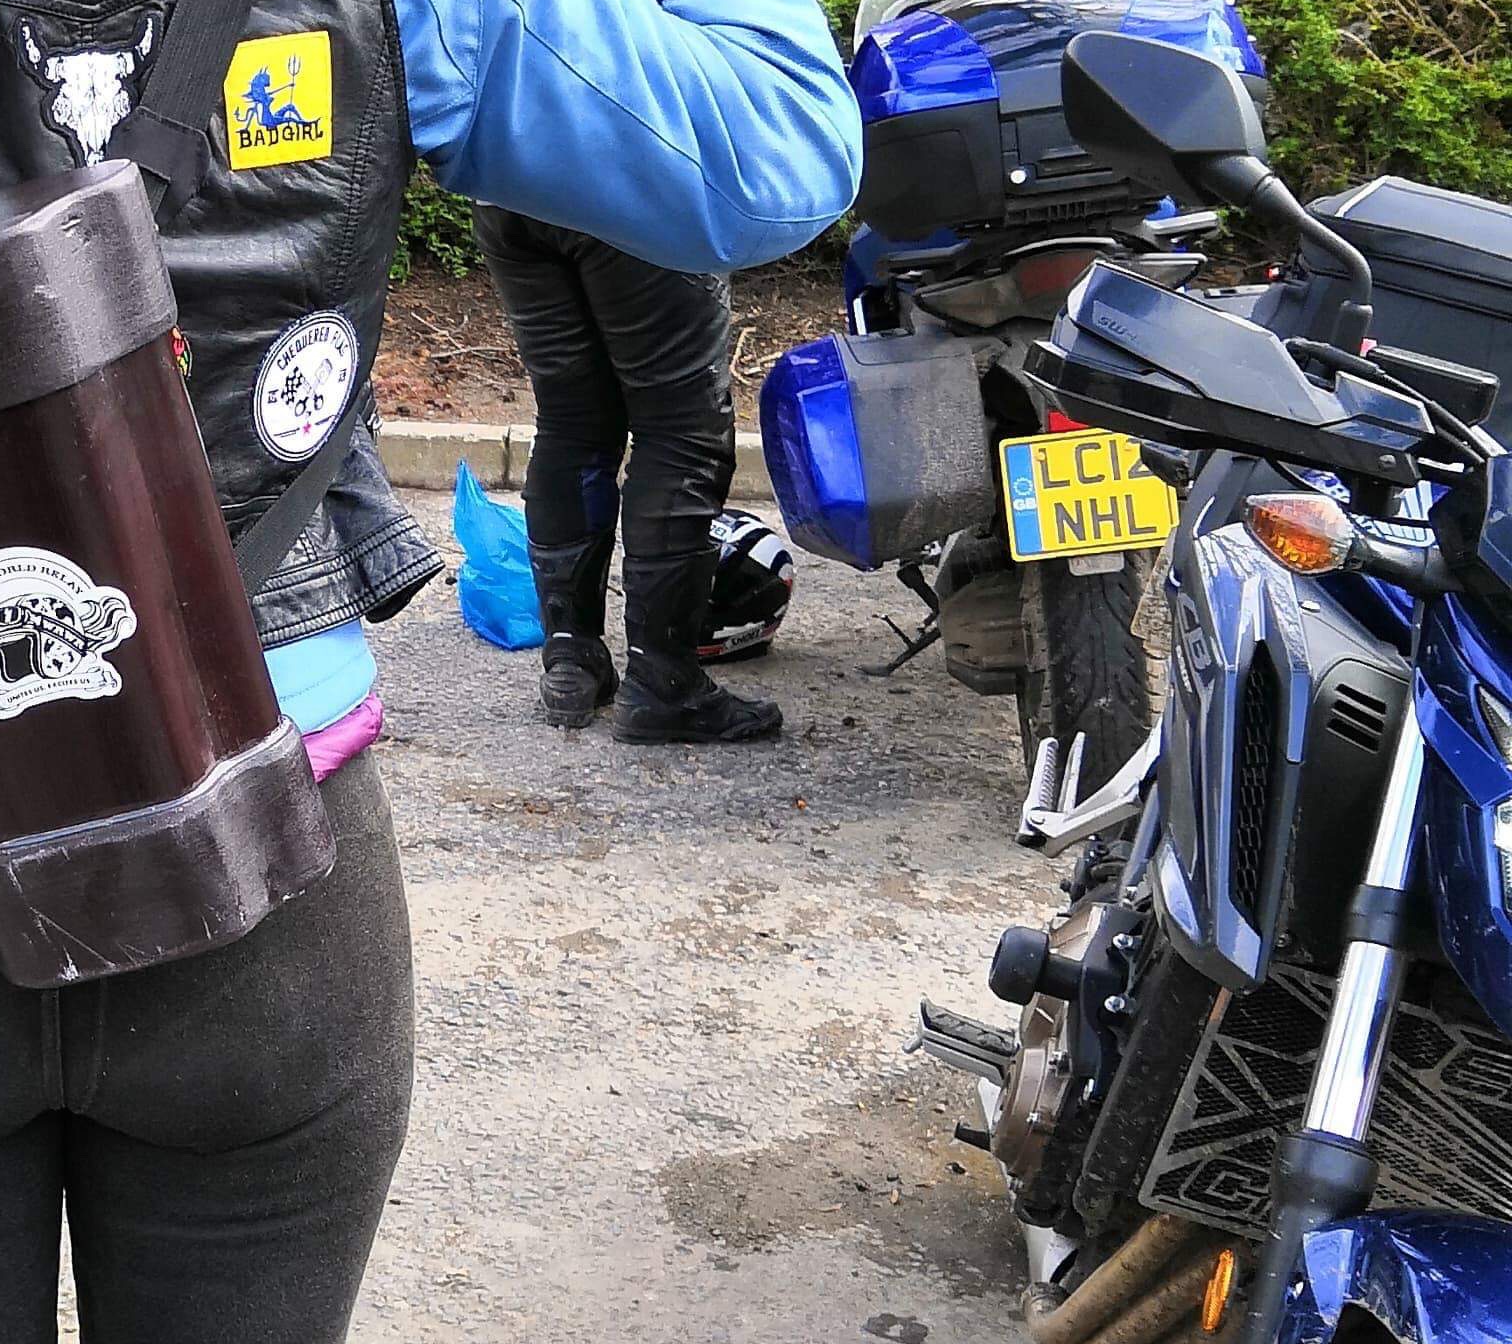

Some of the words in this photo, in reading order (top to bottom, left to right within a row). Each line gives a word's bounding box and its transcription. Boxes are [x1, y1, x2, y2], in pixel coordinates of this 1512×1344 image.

[277, 326, 330, 371] CHEQUERED
[1013, 499, 1037, 511] GB
[1054, 494, 1157, 544] NHL
[40, 566, 84, 595] RELAY
